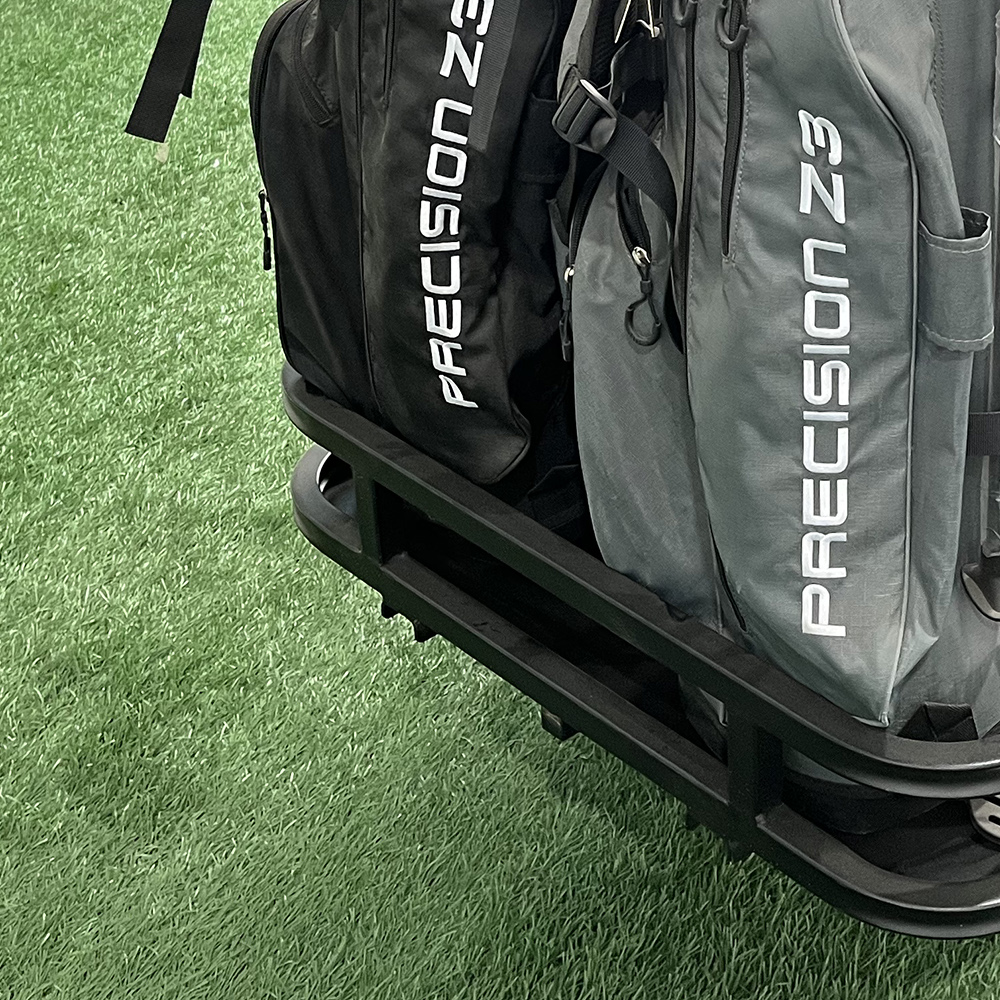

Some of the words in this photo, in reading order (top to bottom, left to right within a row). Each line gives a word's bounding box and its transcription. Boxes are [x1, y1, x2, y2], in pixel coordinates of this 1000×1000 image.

[420, 98, 479, 410] PRECISION
[799, 108, 846, 225] Z3
[801, 237, 851, 639] PRECISION
